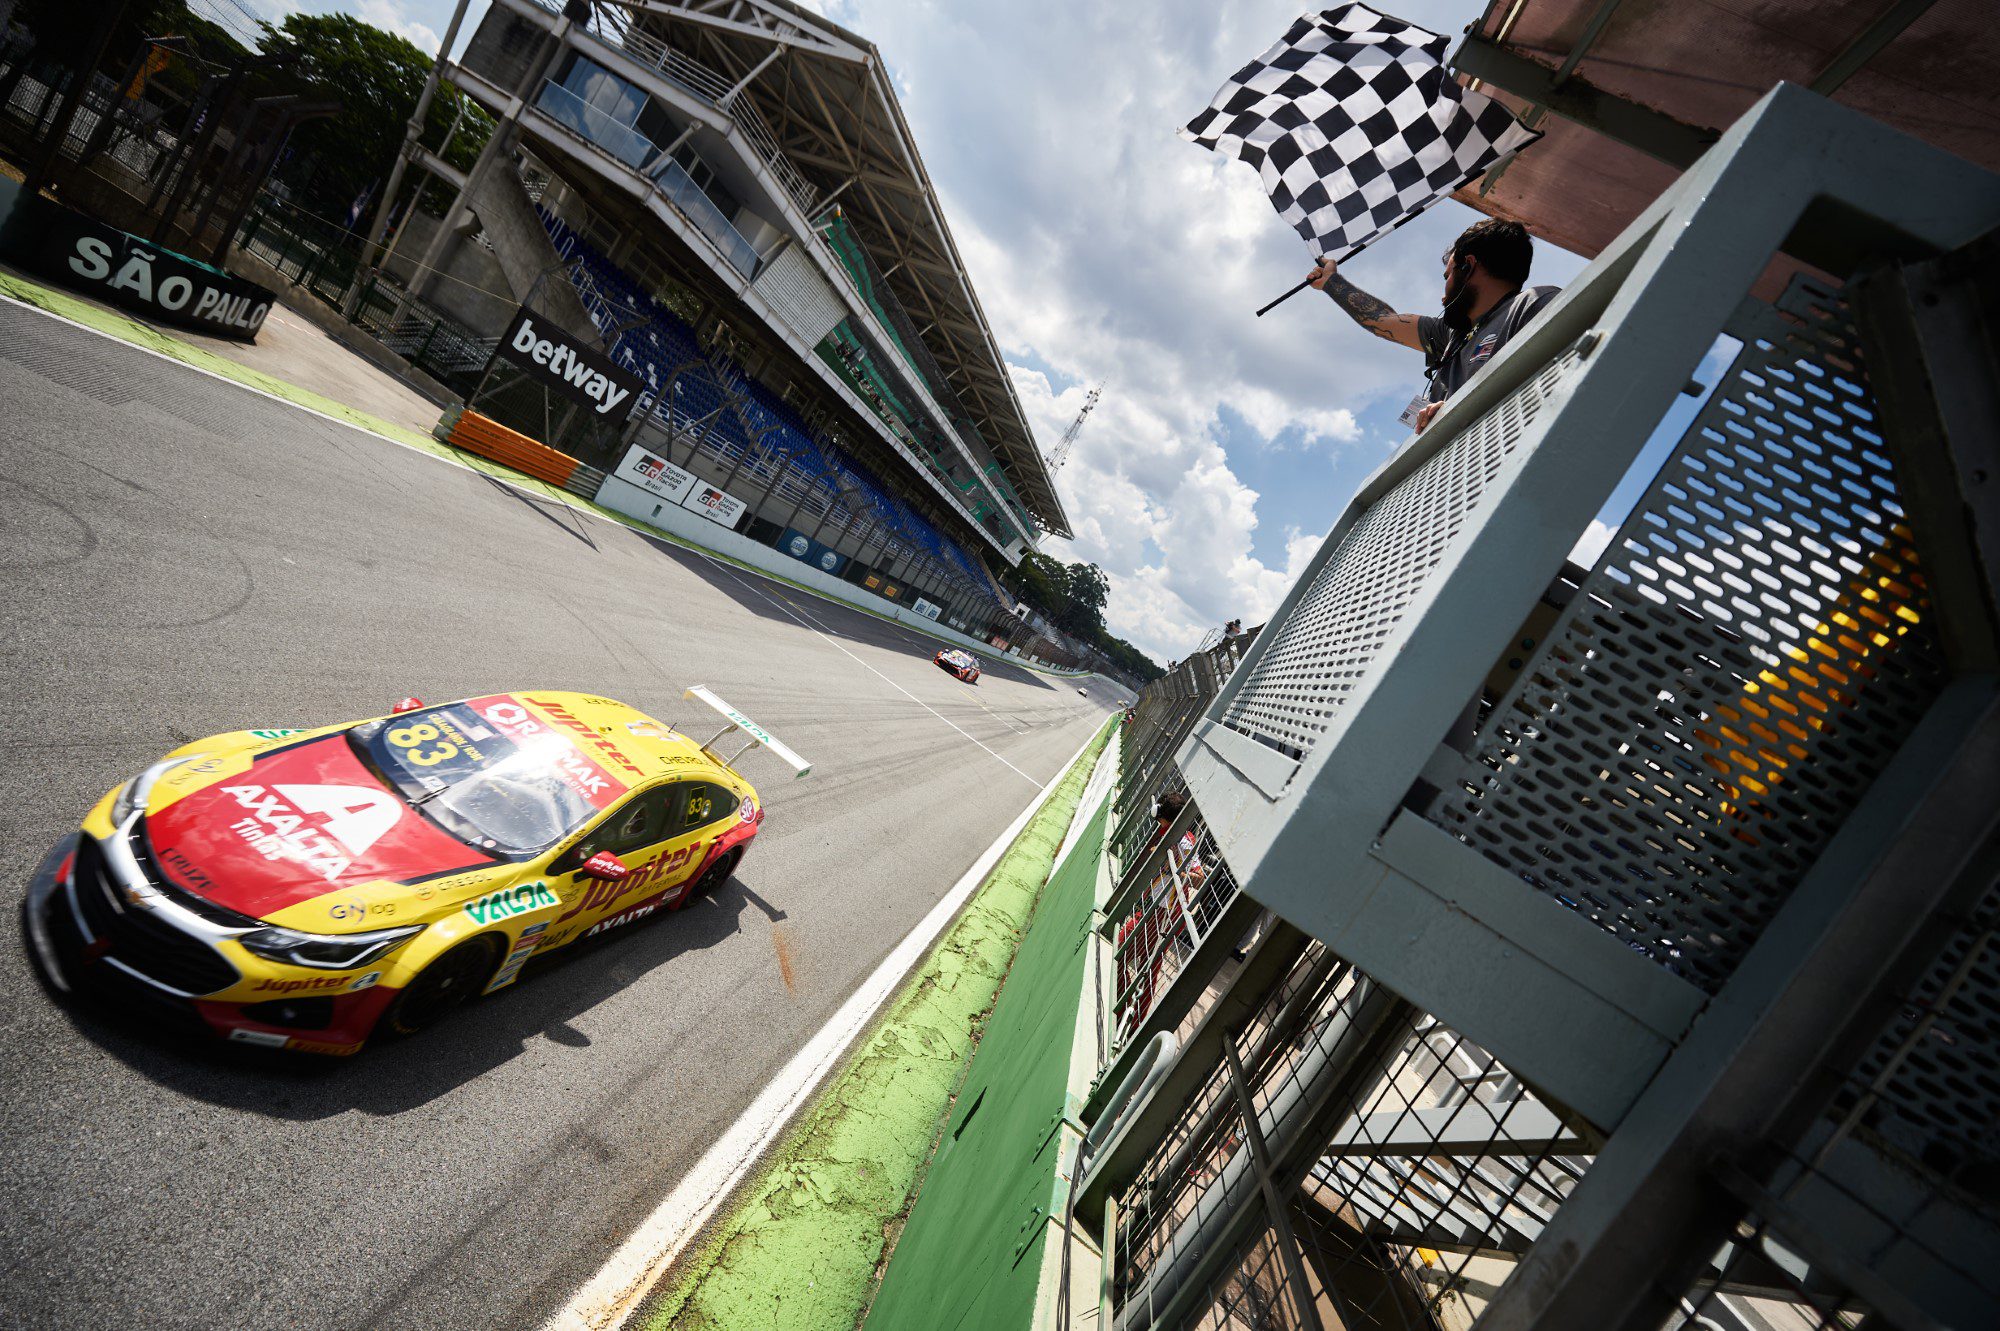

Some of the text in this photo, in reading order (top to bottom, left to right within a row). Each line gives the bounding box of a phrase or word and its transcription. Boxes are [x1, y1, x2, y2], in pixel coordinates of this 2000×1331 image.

[69, 236, 268, 330] SÃO PAULO
[512, 318, 630, 414] betway
[633, 461, 661, 480] GR
[666, 466, 688, 482] TOYOTA
[645, 480, 663, 492] Brasil
[656, 476, 678, 491] Racing
[660, 472, 682, 486] GAZOO
[697, 493, 716, 509] GR
[718, 501, 735, 513] GAZOO
[721, 496, 740, 509] TOYOTA
[705, 509, 720, 519] Brasil
[715, 505, 731, 517] Racing
[388, 723, 459, 767] 83
[689, 797, 703, 816] 83
[220, 785, 352, 882] AXALTA
